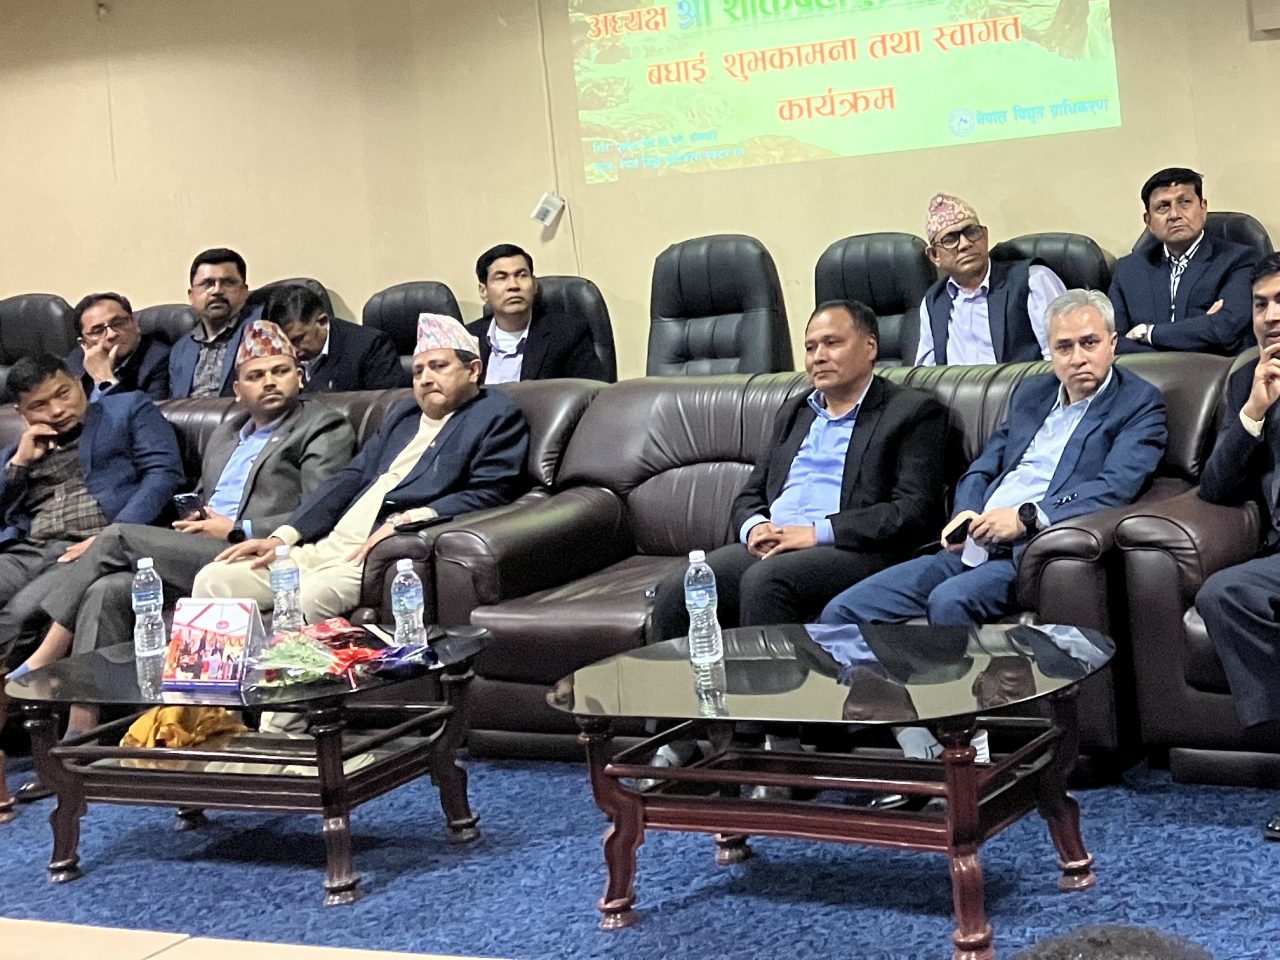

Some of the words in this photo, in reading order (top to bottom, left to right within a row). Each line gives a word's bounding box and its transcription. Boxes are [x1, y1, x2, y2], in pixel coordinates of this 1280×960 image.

[587, 6, 668, 39] अध्यक्ष
[723, 37, 857, 82] शुभकामना
[868, 29, 922, 59] तथा
[933, 16, 1022, 51] स्वागत
[777, 86, 896, 122] कार्यक्रम
